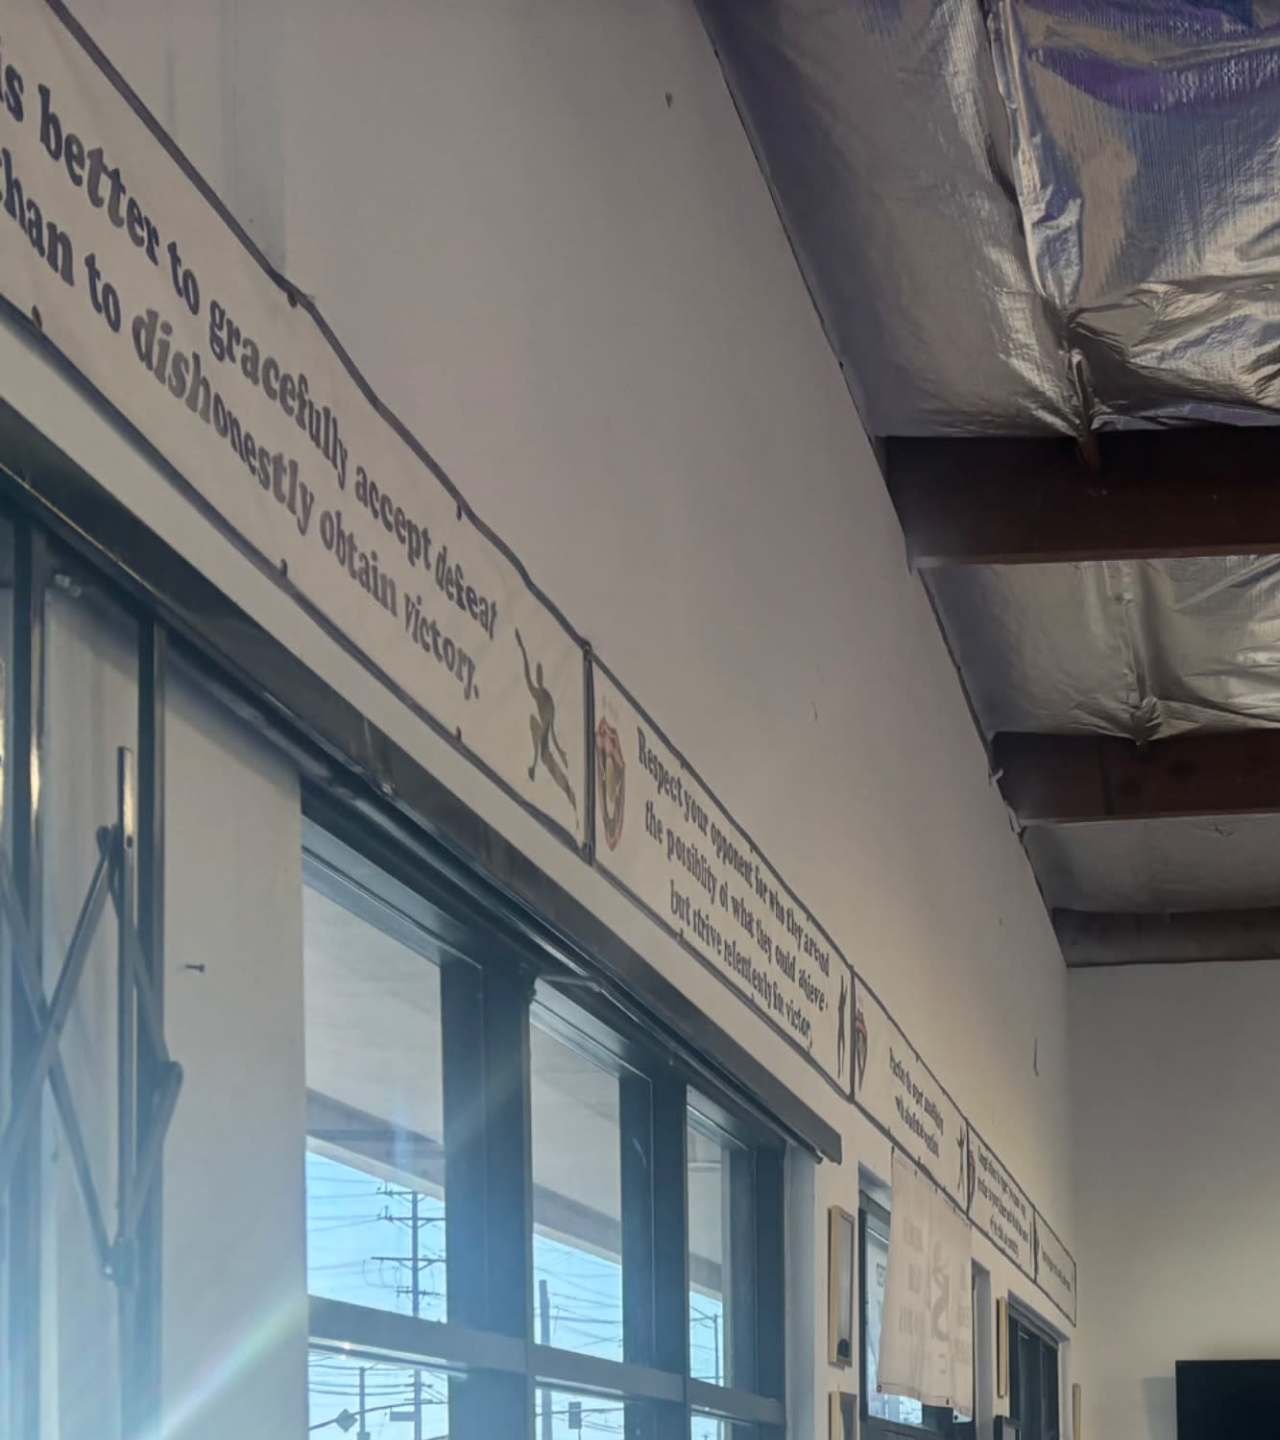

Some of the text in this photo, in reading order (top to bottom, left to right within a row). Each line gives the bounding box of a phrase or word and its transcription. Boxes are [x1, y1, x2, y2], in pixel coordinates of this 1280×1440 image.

[0, 52, 497, 640] s better to gracefully accept defeat
[0, 147, 479, 700] han to dishonestly obtain victory.
[637, 725, 683, 807] Respect
[684, 795, 708, 836] your
[710, 821, 753, 888] opponent
[755, 861, 768, 904] for
[769, 890, 784, 931] who
[786, 907, 804, 952] they
[645, 800, 663, 845] the
[719, 880, 728, 910] of
[731, 892, 754, 938] what
[755, 918, 772, 965] they
[775, 944, 796, 985] could
[670, 879, 691, 930] but
[692, 909, 722, 957] strive
